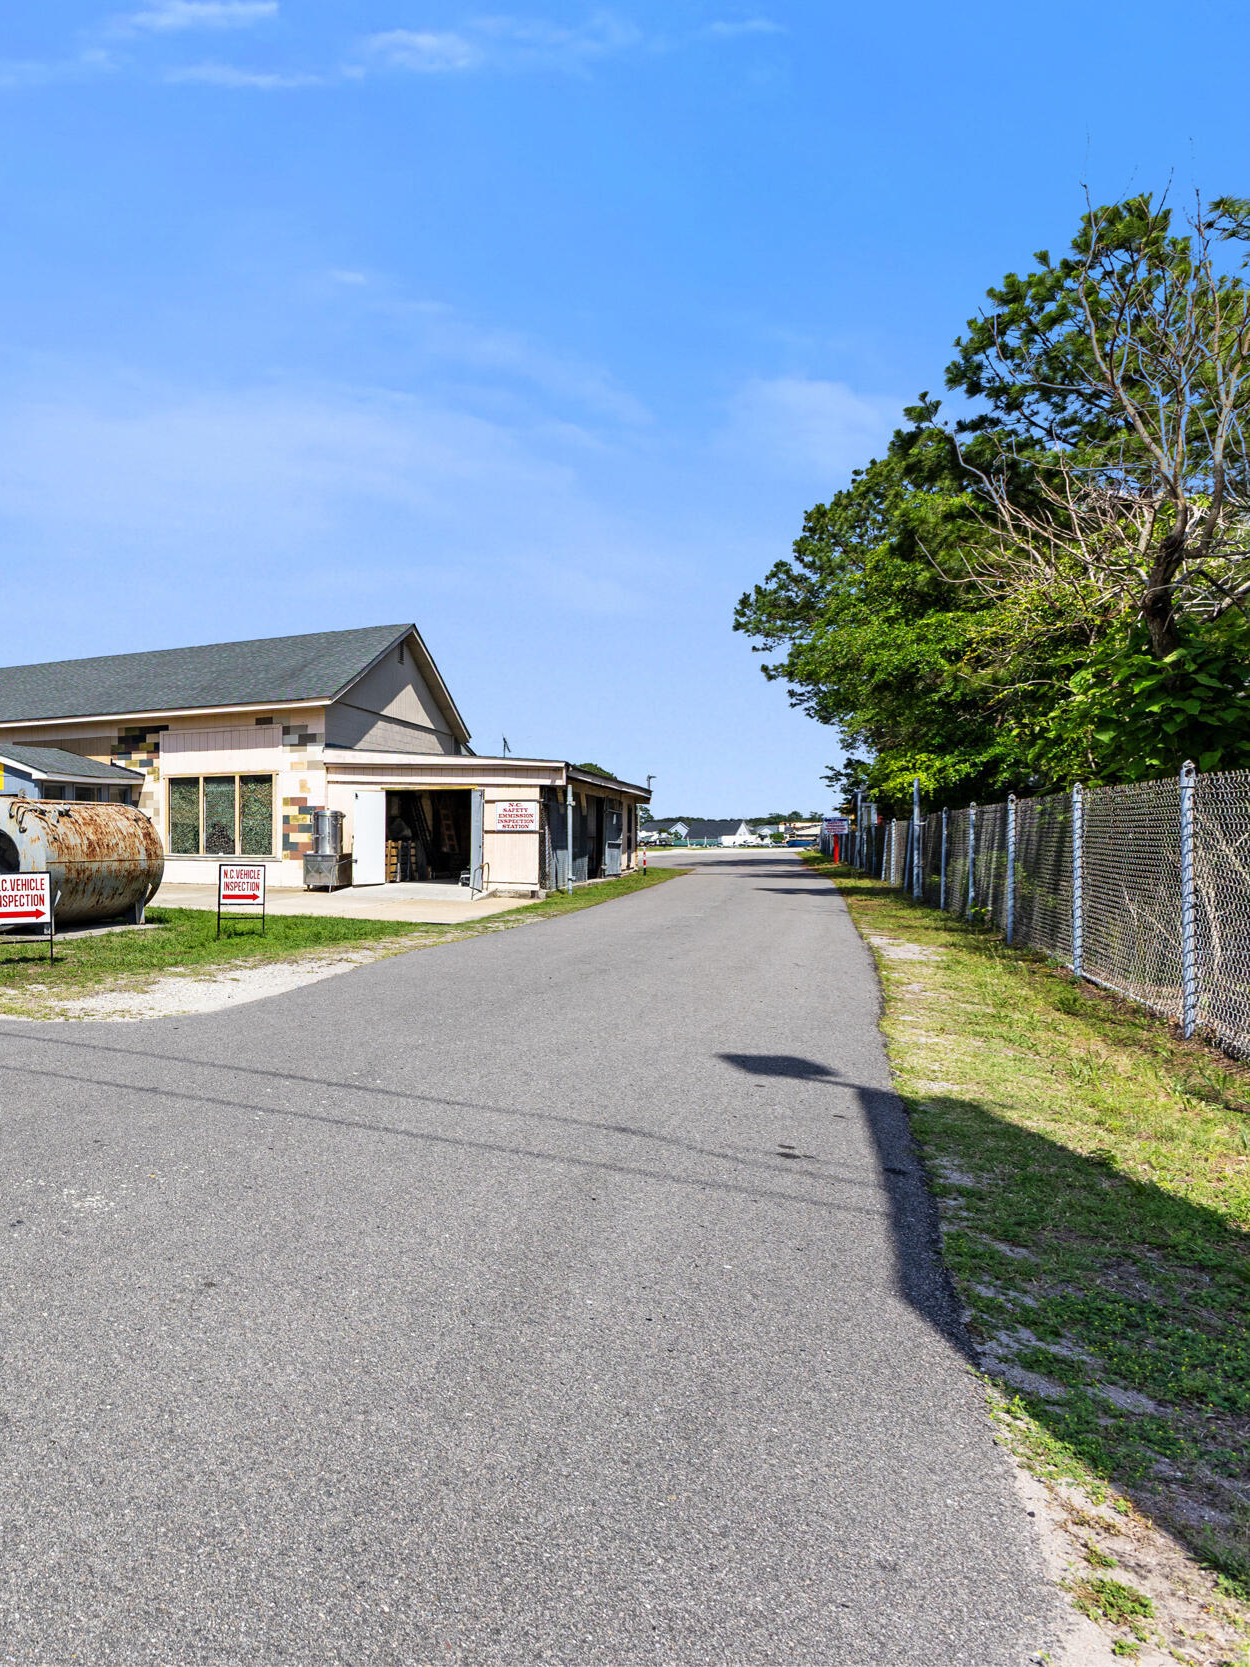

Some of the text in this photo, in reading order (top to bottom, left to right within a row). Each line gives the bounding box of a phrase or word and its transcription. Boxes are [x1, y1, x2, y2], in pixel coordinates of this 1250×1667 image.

[236, 869, 261, 879] VEHICLE
[10, 878, 45, 892] VEHICLE
[223, 881, 260, 892] INSPECTION
